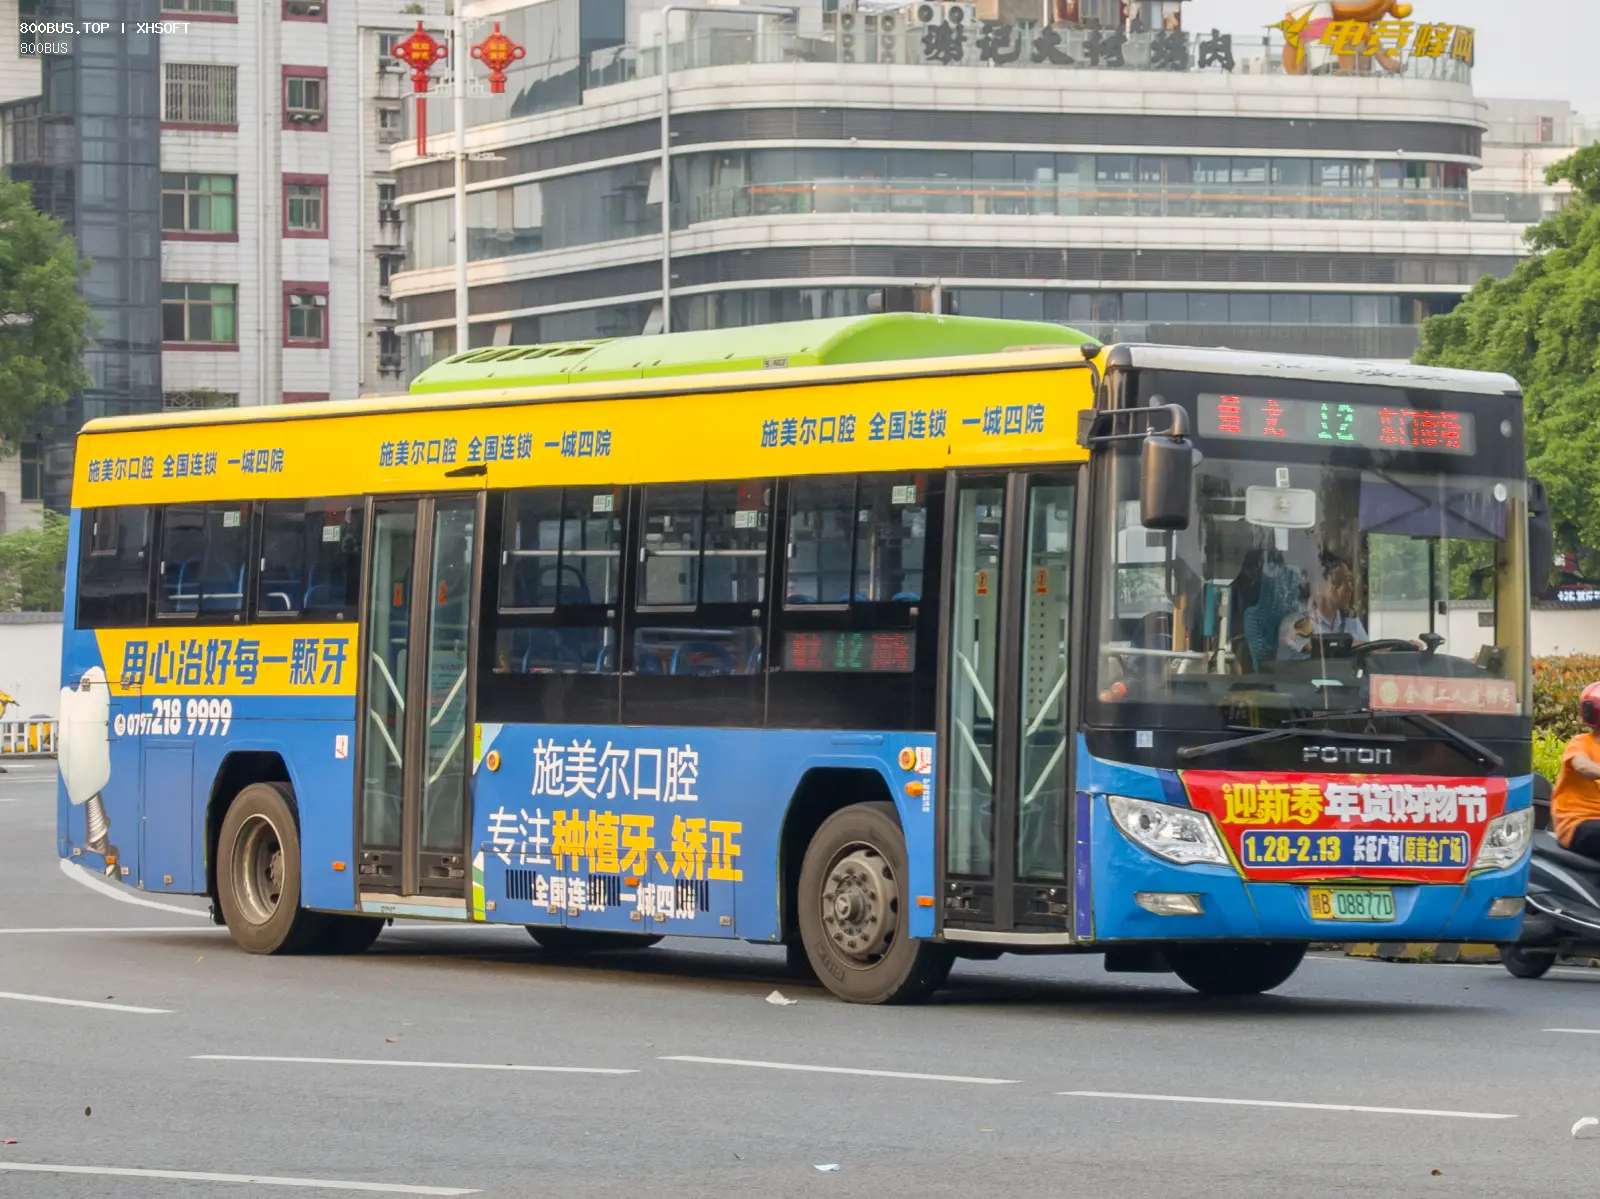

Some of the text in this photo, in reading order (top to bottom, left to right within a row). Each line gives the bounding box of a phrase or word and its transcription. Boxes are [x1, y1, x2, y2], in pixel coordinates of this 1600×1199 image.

[761, 402, 1046, 448] 施美尔口腔 全国连锁 一城四院
[1317, 402, 1355, 441] 12
[87, 447, 285, 483] 施美尔口腔 全国连锁 一城四院
[379, 429, 613, 467] 施美尔口腔 全国连锁 一城四院
[120, 637, 350, 686] 用心治好每一颗牙
[531, 738, 700, 803] 施美尔口腔
[1303, 746, 1391, 764] FOTON
[1221, 779, 1489, 825] 迎新春年货购物节
[487, 805, 743, 882] 专注种植牙、矫正
[1245, 836, 1341, 862] 1.28-2.13
